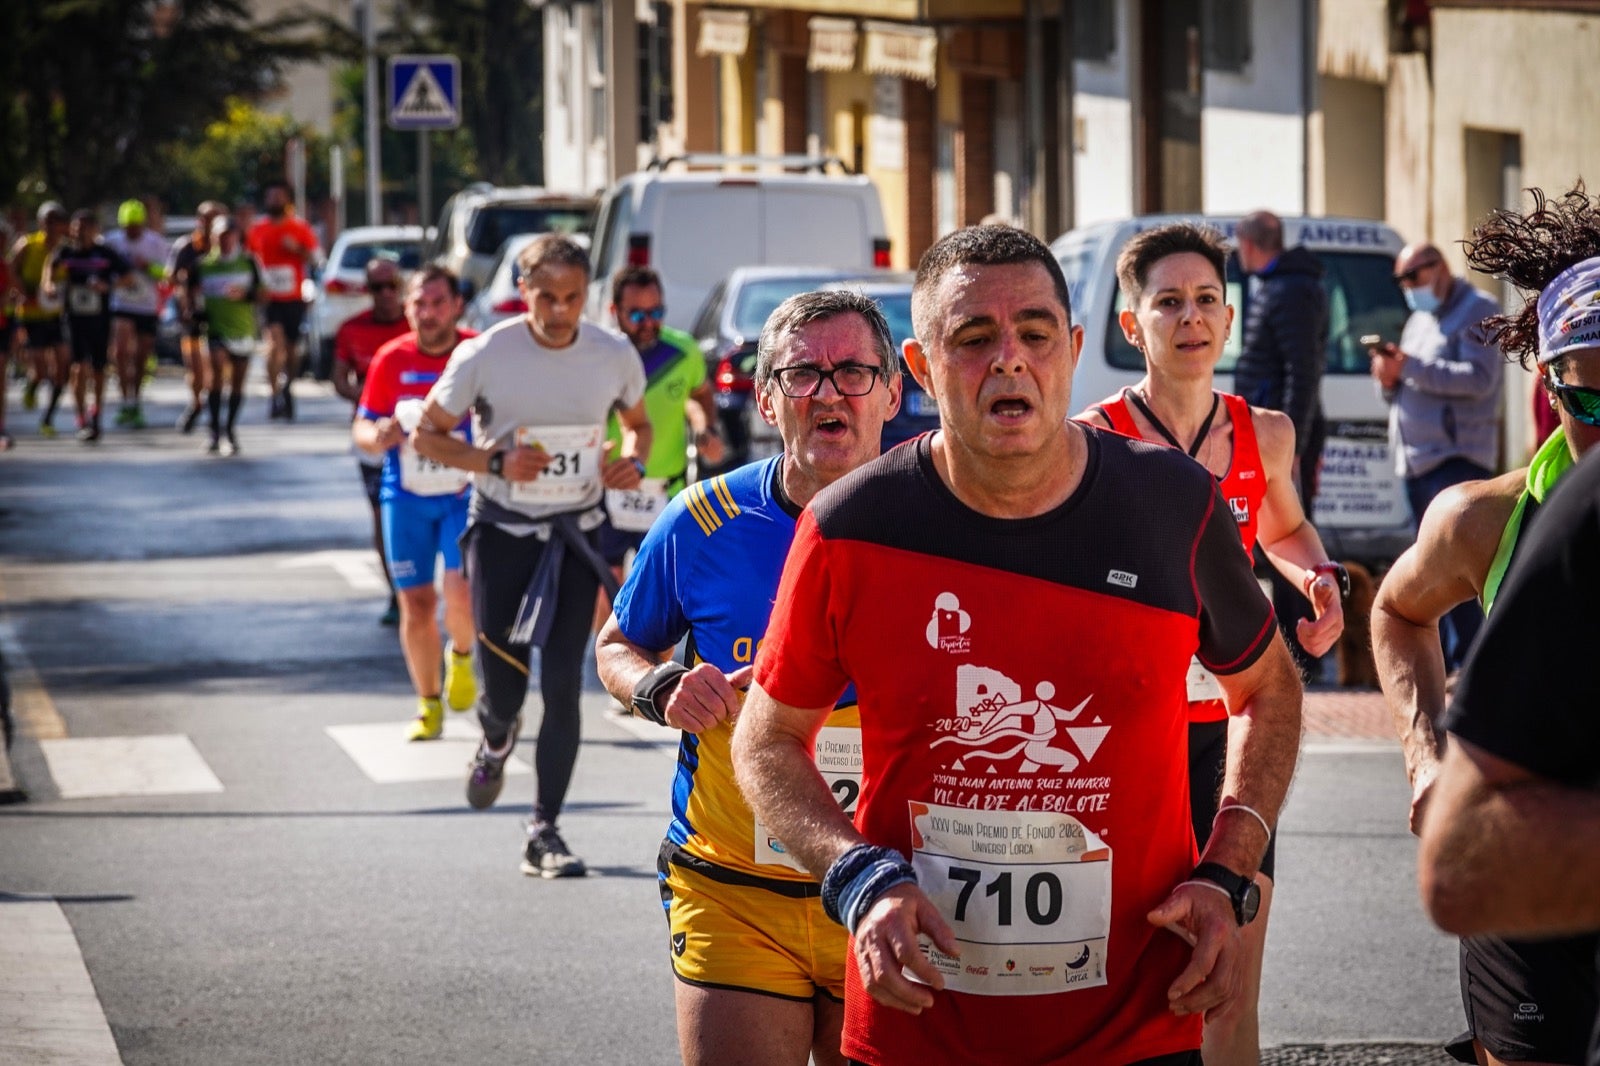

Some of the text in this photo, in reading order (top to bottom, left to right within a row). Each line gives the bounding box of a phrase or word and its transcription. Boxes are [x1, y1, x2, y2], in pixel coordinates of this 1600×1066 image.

[1300, 223, 1386, 244] ANGEL
[543, 451, 580, 476] 31
[959, 777, 985, 788] JUAN
[989, 777, 1034, 790] ANTONIO
[1037, 777, 1062, 790] RUIZ
[1066, 776, 1112, 789] NAVARRO
[934, 787, 1111, 813] VILLA DE ALBOLOTE
[930, 815, 950, 833] XXXV
[948, 866, 1062, 926] 710
